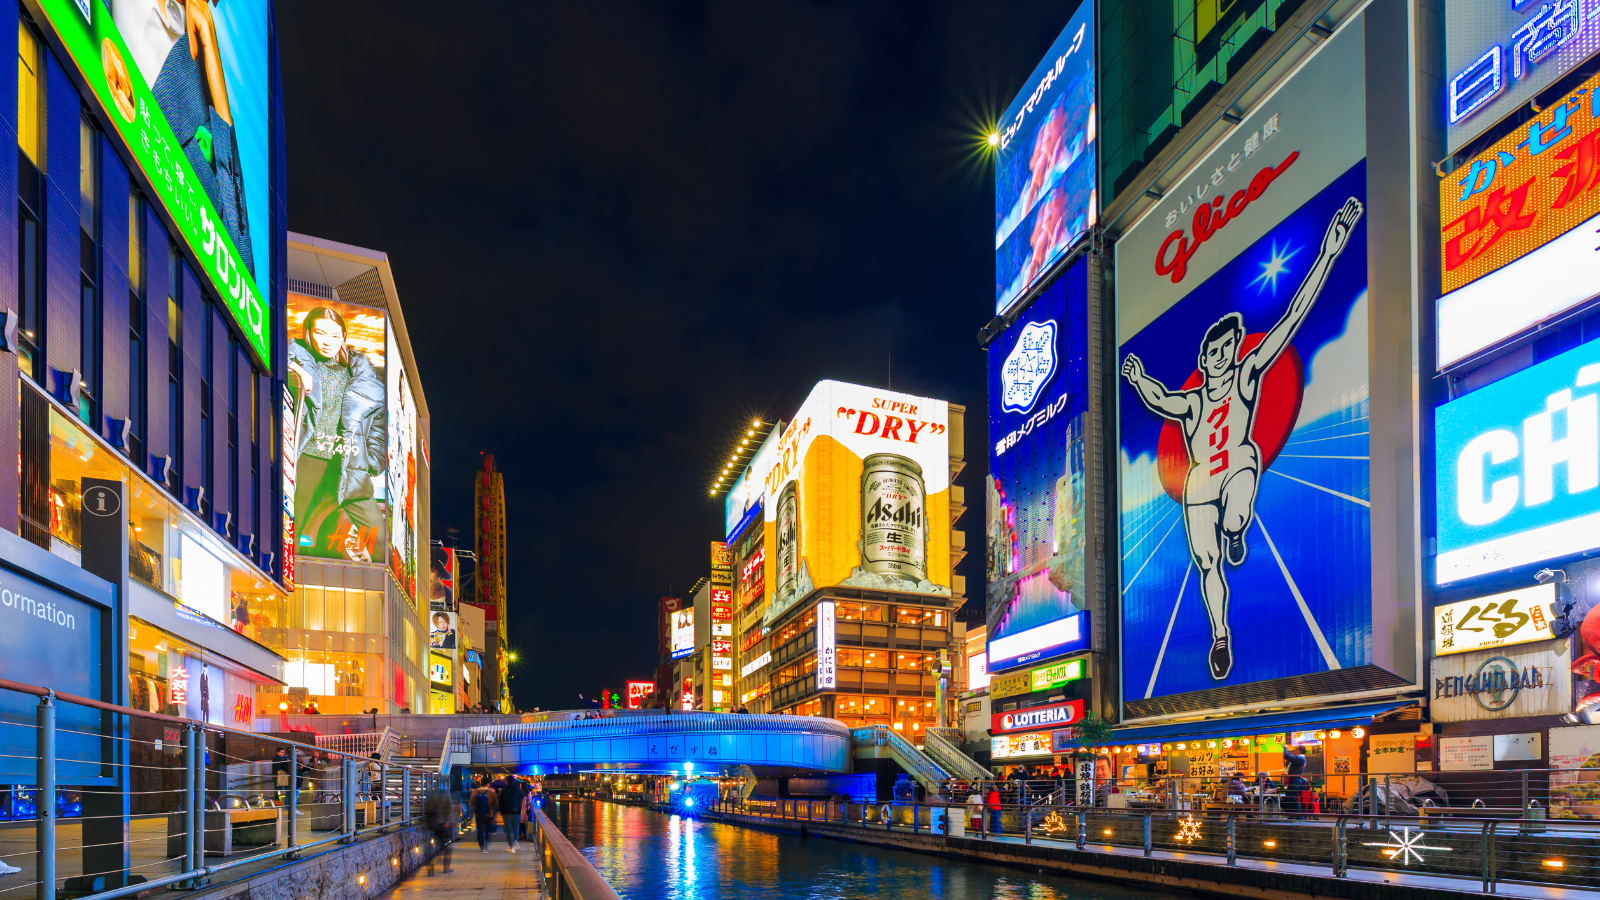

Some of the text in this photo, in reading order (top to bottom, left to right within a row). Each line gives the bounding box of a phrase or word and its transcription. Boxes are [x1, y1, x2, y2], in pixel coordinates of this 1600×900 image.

[1450, 0, 1600, 124] 日商
[1459, 87, 1600, 202] かぜ
[1165, 113, 1281, 229] おいしさと健康
[1155, 151, 1299, 284] Glico
[200, 204, 266, 349] サロンパス
[872, 397, 918, 416] SUPER
[995, 392, 1068, 457] 雪印メグミルク
[1206, 396, 1232, 478] グリコ
[316, 441, 360, 457] ¥7,499
[867, 496, 921, 529] Asahi
[327, 522, 379, 557] H&M
[879, 545, 911, 554] スーパードライ
[886, 532, 903, 545] 生
[0, 581, 75, 630] ormation
[1455, 598, 1530, 639] くくる
[1479, 638, 1505, 647] KUKURU
[1435, 665, 1544, 700] PENGUIN BAR
[1015, 707, 1067, 726] LOTTERIA
[650, 744, 717, 756] えびす橋
[1190, 765, 1215, 777] お好み
